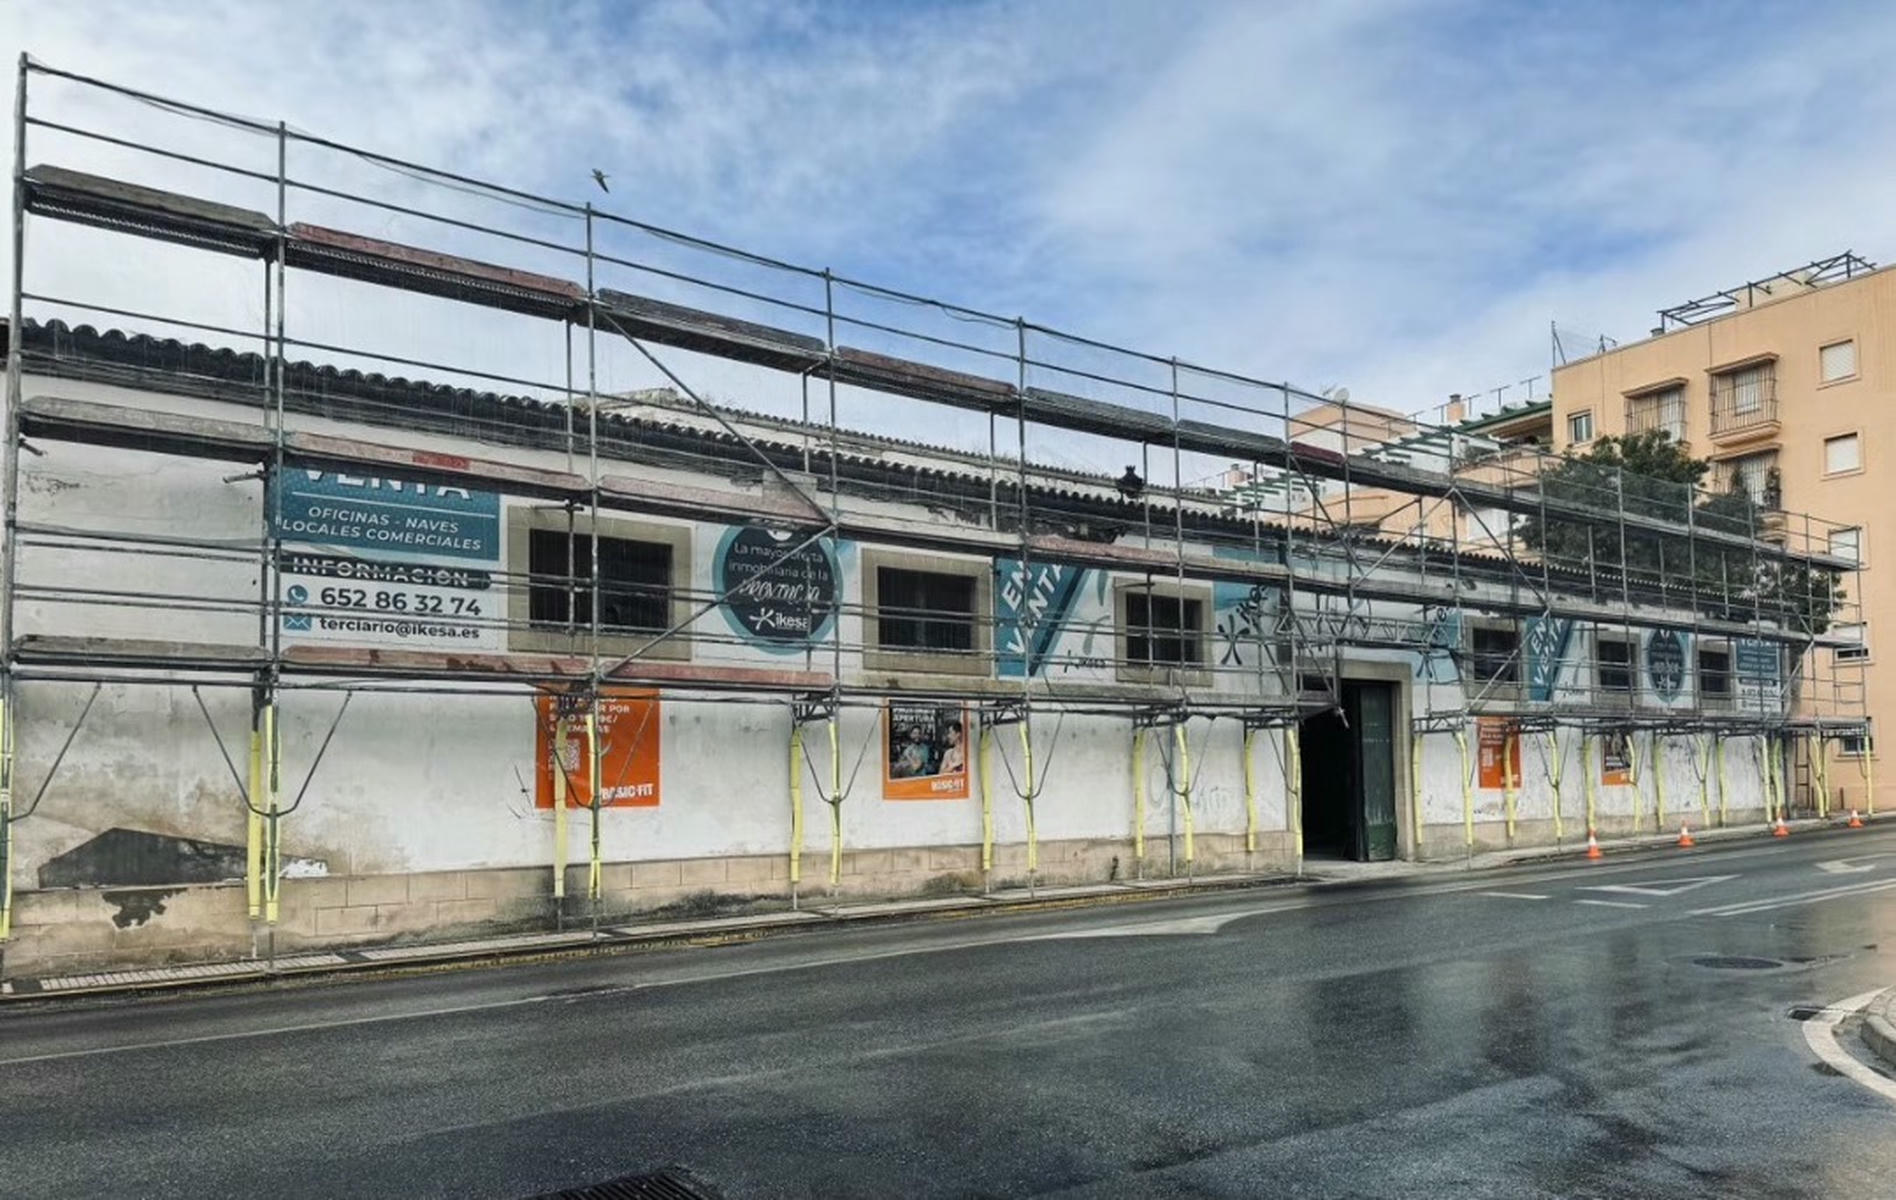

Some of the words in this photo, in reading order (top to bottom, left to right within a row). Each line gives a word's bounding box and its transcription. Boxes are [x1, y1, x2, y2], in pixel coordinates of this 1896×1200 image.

[282, 519, 362, 538] LOCALES
[366, 528, 482, 550] COMERCIALES
[308, 507, 390, 526] OFICINAS
[405, 517, 459, 534] NAVES
[320, 587, 368, 609] 652
[375, 591, 408, 611] 86
[414, 594, 443, 614] 32
[450, 597, 482, 617] 74
